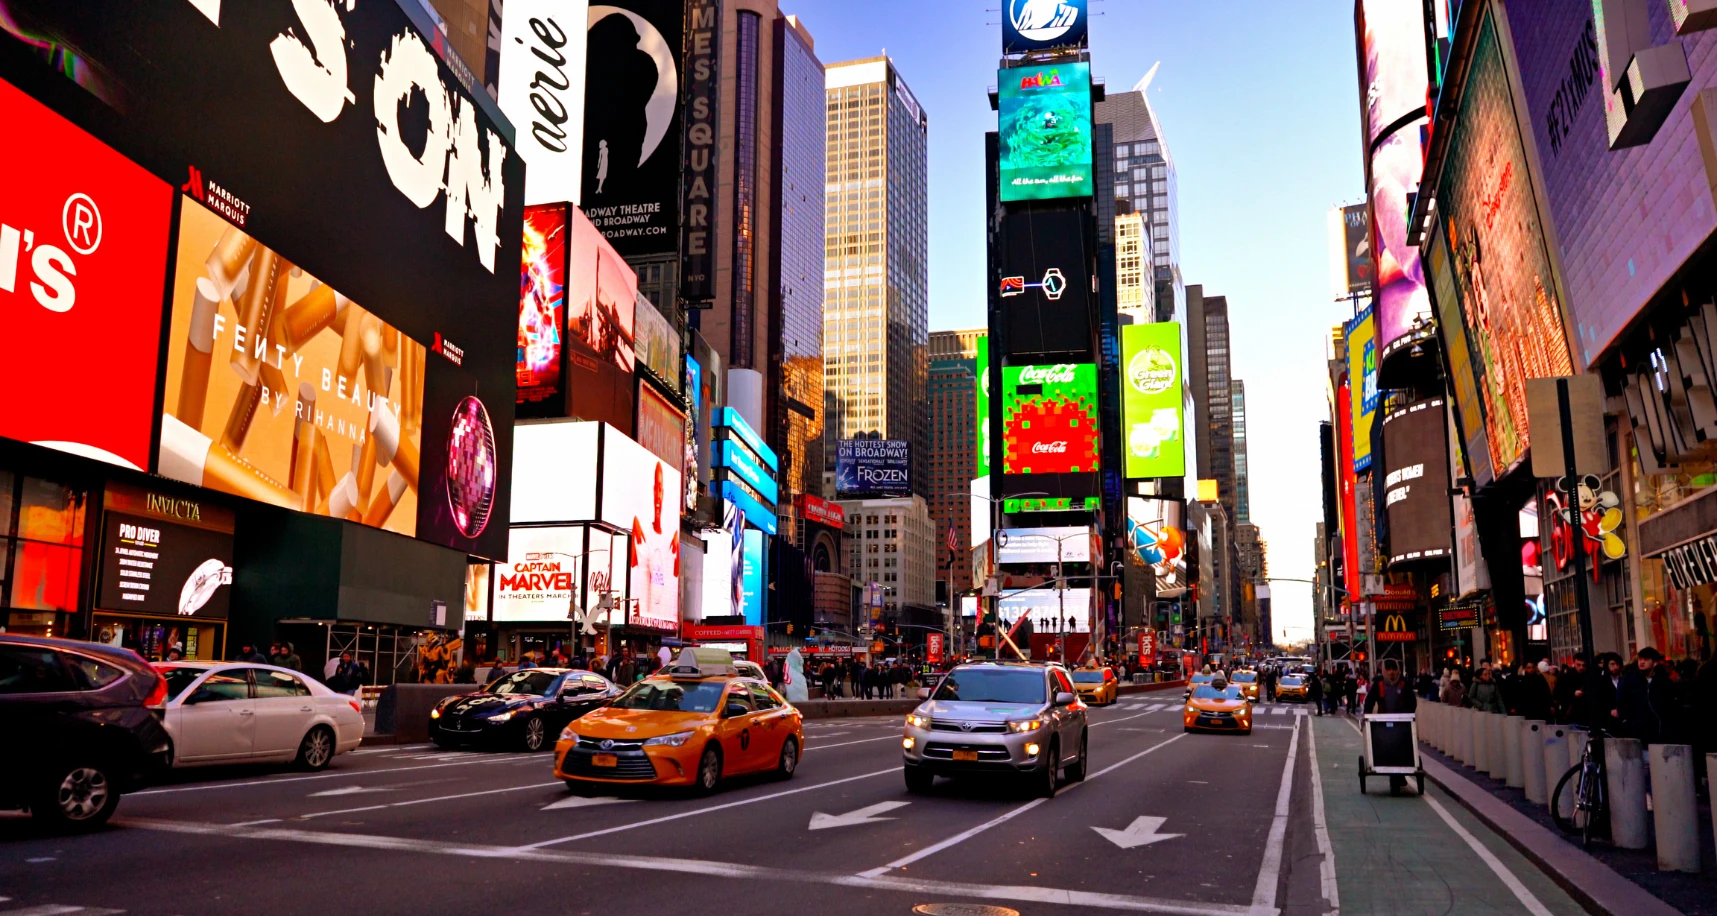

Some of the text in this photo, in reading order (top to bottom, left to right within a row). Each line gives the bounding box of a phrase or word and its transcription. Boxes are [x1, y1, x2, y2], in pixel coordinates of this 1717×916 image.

[514, 17, 570, 153] aerie
[688, 96, 713, 256] SQUARE
[209, 180, 251, 215] MARRIOTT
[208, 194, 245, 225] MARQUIS
[620, 202, 660, 215] THEATRE
[604, 214, 651, 226] BROADWAY
[1019, 364, 1077, 385] Coca-Cola
[322, 368, 402, 419] BEAUTY
[261, 387, 283, 409] BY
[295, 401, 366, 445] RIHANNA
[839, 447, 908, 458] ON BROADWAY!
[887, 441, 908, 449] SNOW
[1032, 441, 1068, 453] Coca-Cola
[857, 466, 908, 485] FROZEN
[146, 493, 201, 521] INVICTA
[119, 523, 160, 544] PRO DIVER
[514, 562, 561, 573] CAPTAIN
[500, 573, 577, 591] MARVEL
[930, 635, 940, 655] tkts
[1142, 635, 1152, 655] tkts
